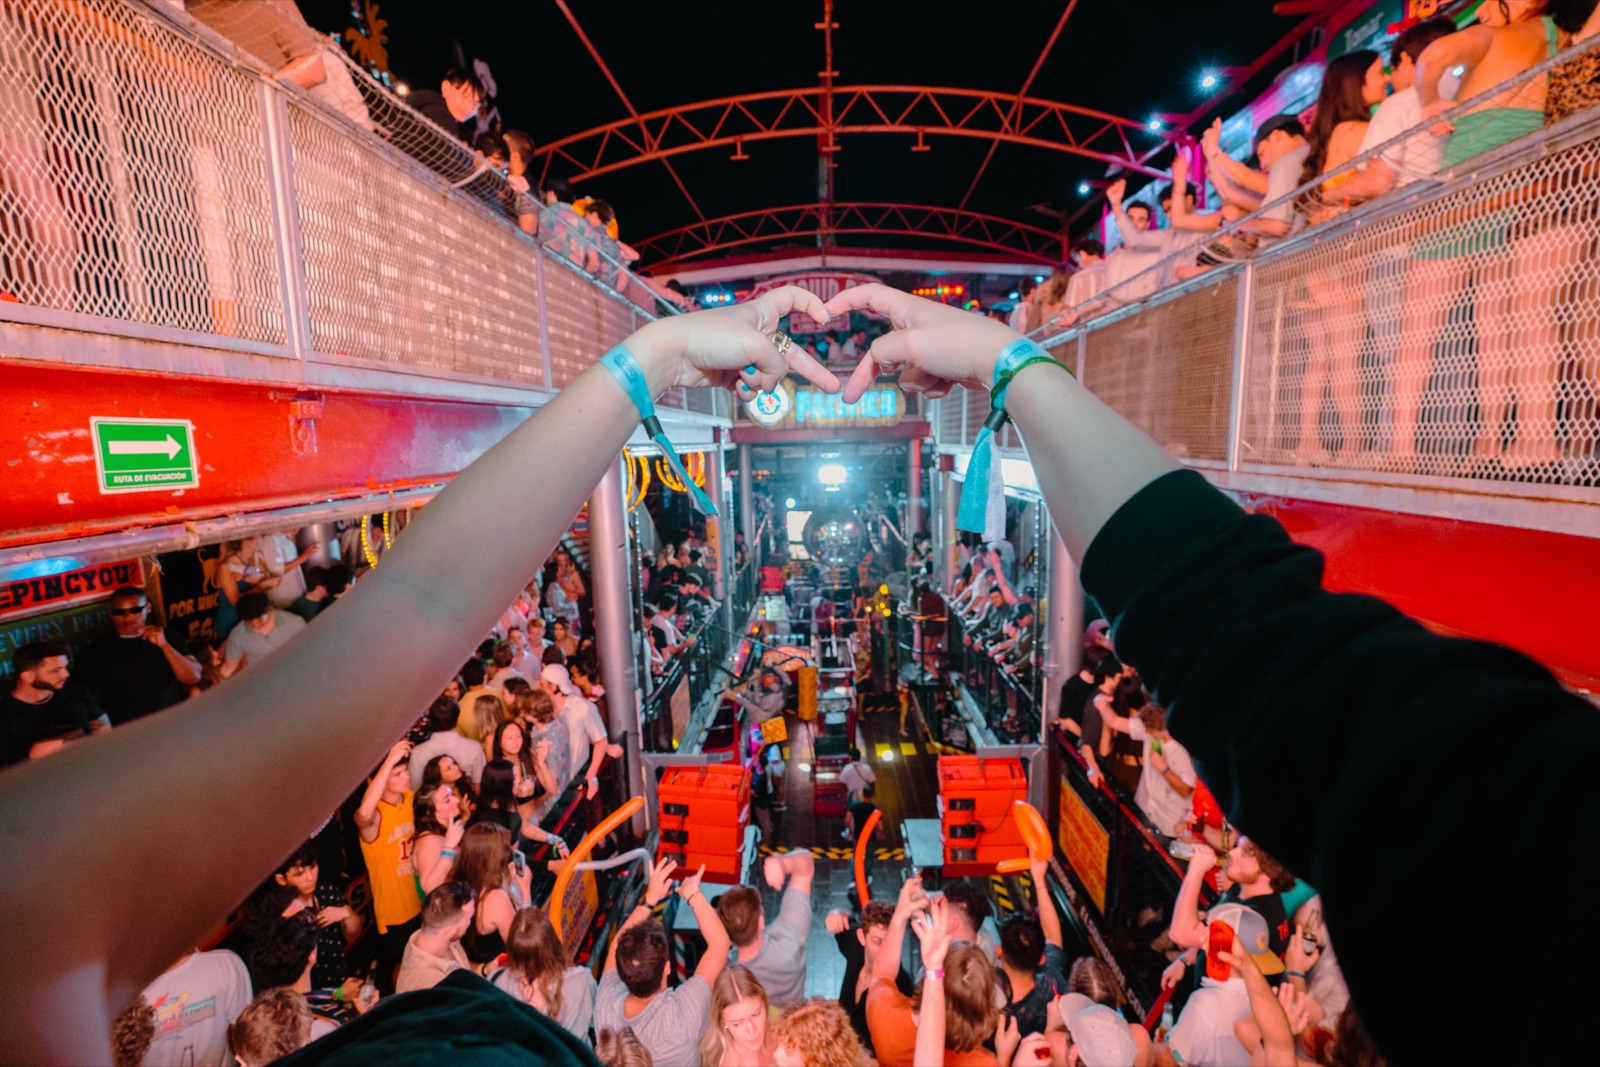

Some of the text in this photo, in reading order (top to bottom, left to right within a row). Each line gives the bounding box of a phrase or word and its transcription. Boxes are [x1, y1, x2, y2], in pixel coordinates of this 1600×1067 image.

[113, 470, 187, 483] RUTA DE EVACUACIÓN
